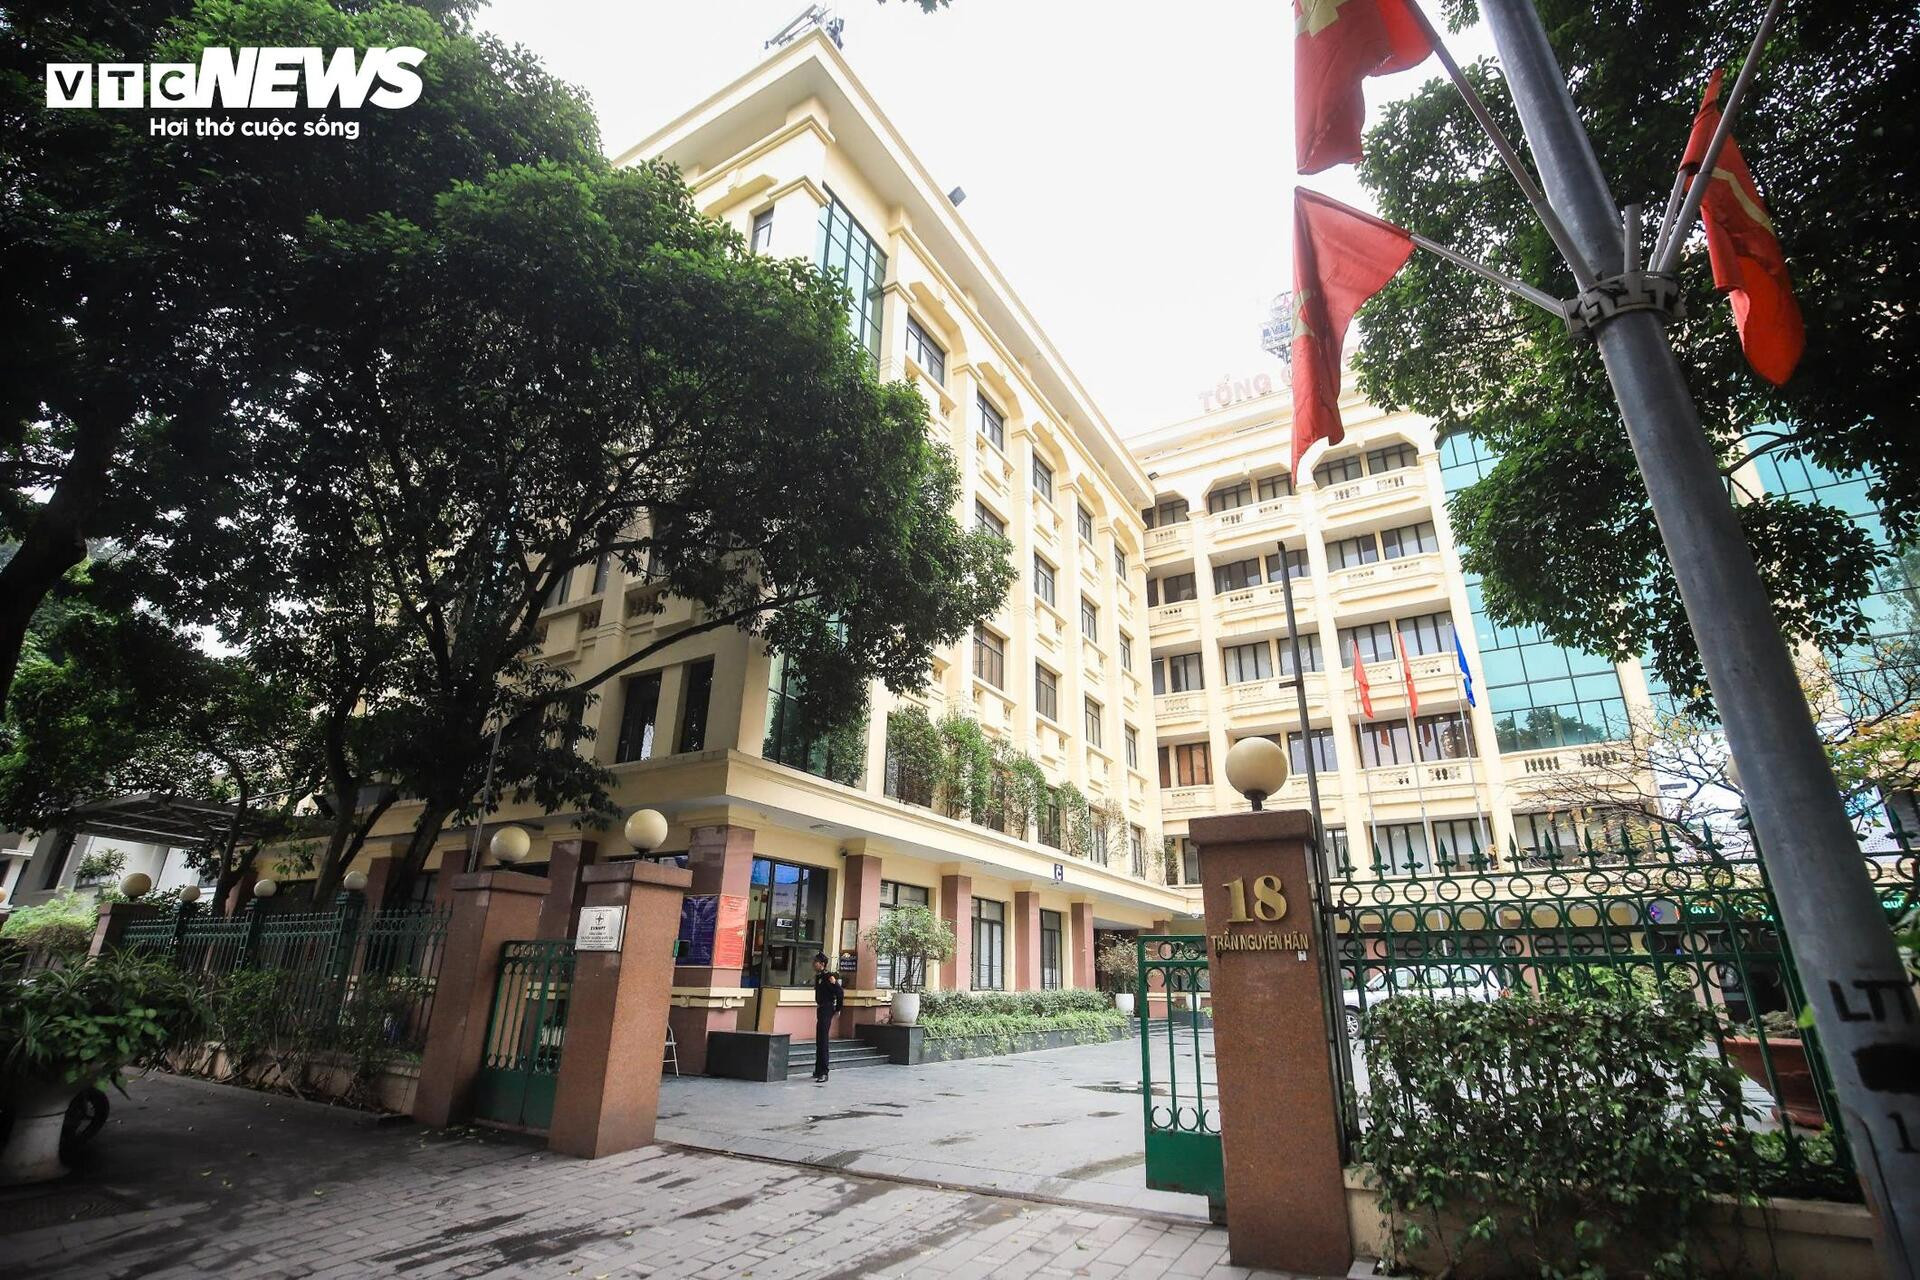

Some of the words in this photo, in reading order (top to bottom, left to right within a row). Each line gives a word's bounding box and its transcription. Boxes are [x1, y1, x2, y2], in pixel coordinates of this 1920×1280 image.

[1222, 874, 1288, 924] 18
[1211, 928, 1239, 951] TRẦN
[1240, 931, 1283, 950] NGUYÊN
[1284, 931, 1309, 950] HÃN
